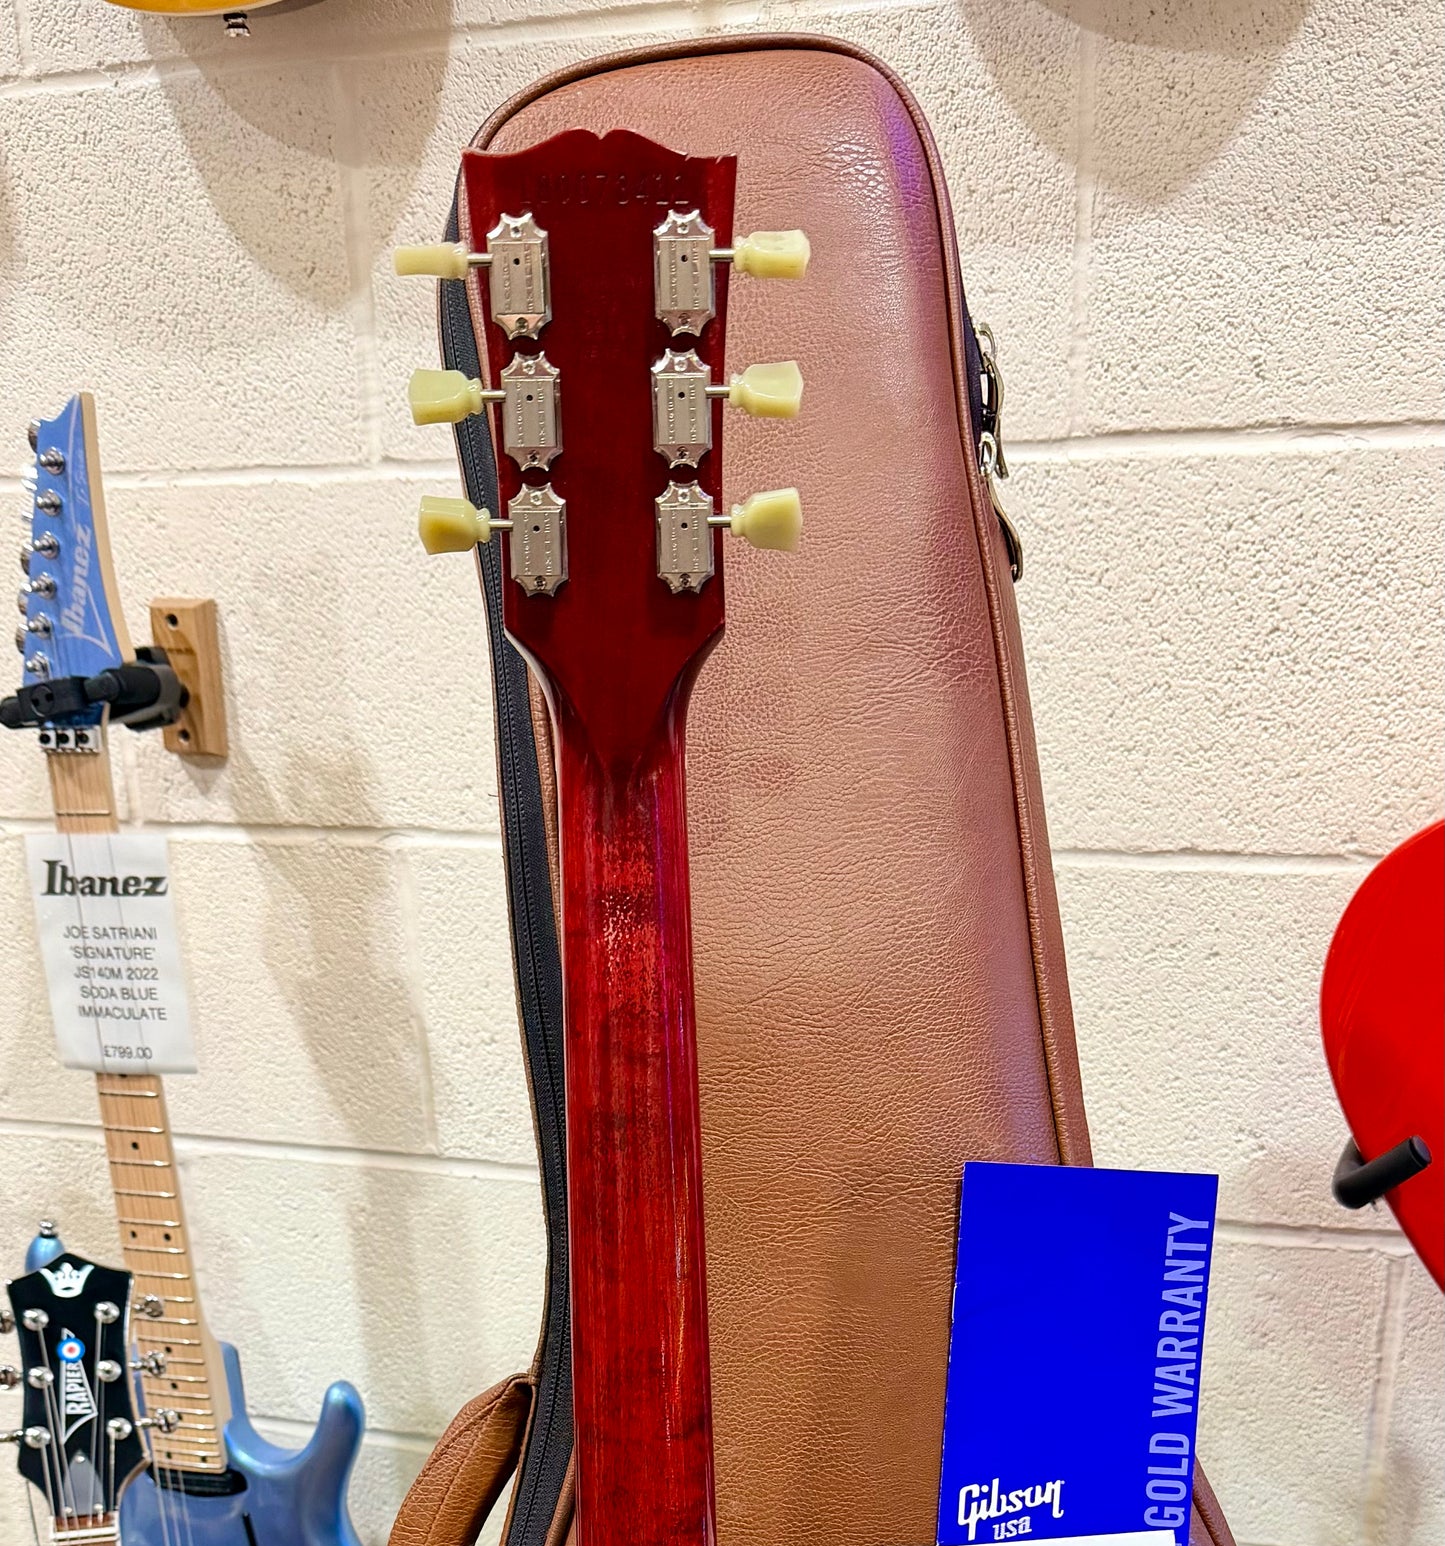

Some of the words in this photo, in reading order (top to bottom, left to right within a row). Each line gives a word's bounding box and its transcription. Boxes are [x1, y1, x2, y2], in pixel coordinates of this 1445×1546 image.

[60, 522, 91, 637] Ibanez
[40, 860, 169, 897] Ibanez
[63, 926, 89, 940] JOE
[92, 926, 157, 940] SATRIANI
[126, 967, 159, 981] 2022
[79, 985, 118, 1000] SODA
[121, 987, 158, 1001] BLUE
[78, 1006, 168, 1021] IMMACULATE
[1152, 1211, 1209, 1418] WARRANTY
[1143, 1432, 1191, 1529] GOLD
[957, 1477, 1065, 1541] Gibson
